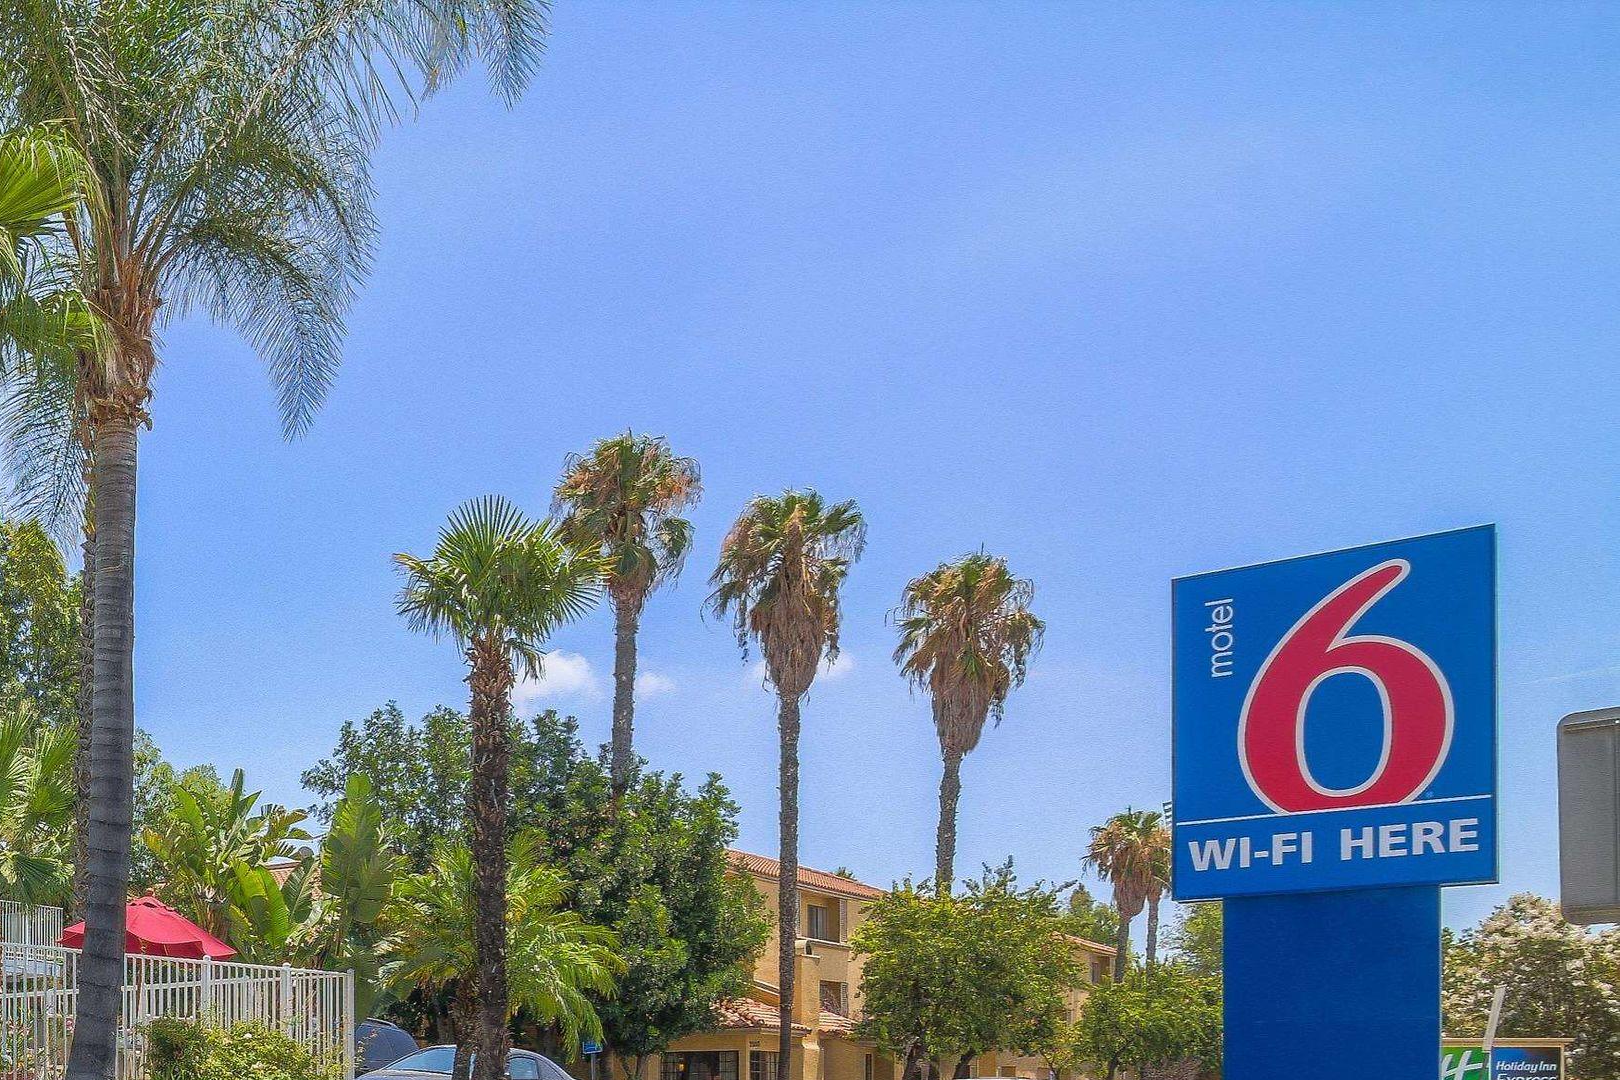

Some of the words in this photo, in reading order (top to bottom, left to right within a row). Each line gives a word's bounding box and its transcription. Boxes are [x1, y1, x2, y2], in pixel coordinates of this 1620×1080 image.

[1204, 598, 1234, 678] motel
[1237, 558, 1455, 817] 6
[1188, 831, 1313, 872] WI-FI
[1340, 817, 1480, 861] HERE
[1495, 1061, 1537, 1073] Holiday
[1538, 1061, 1557, 1071] Inn
